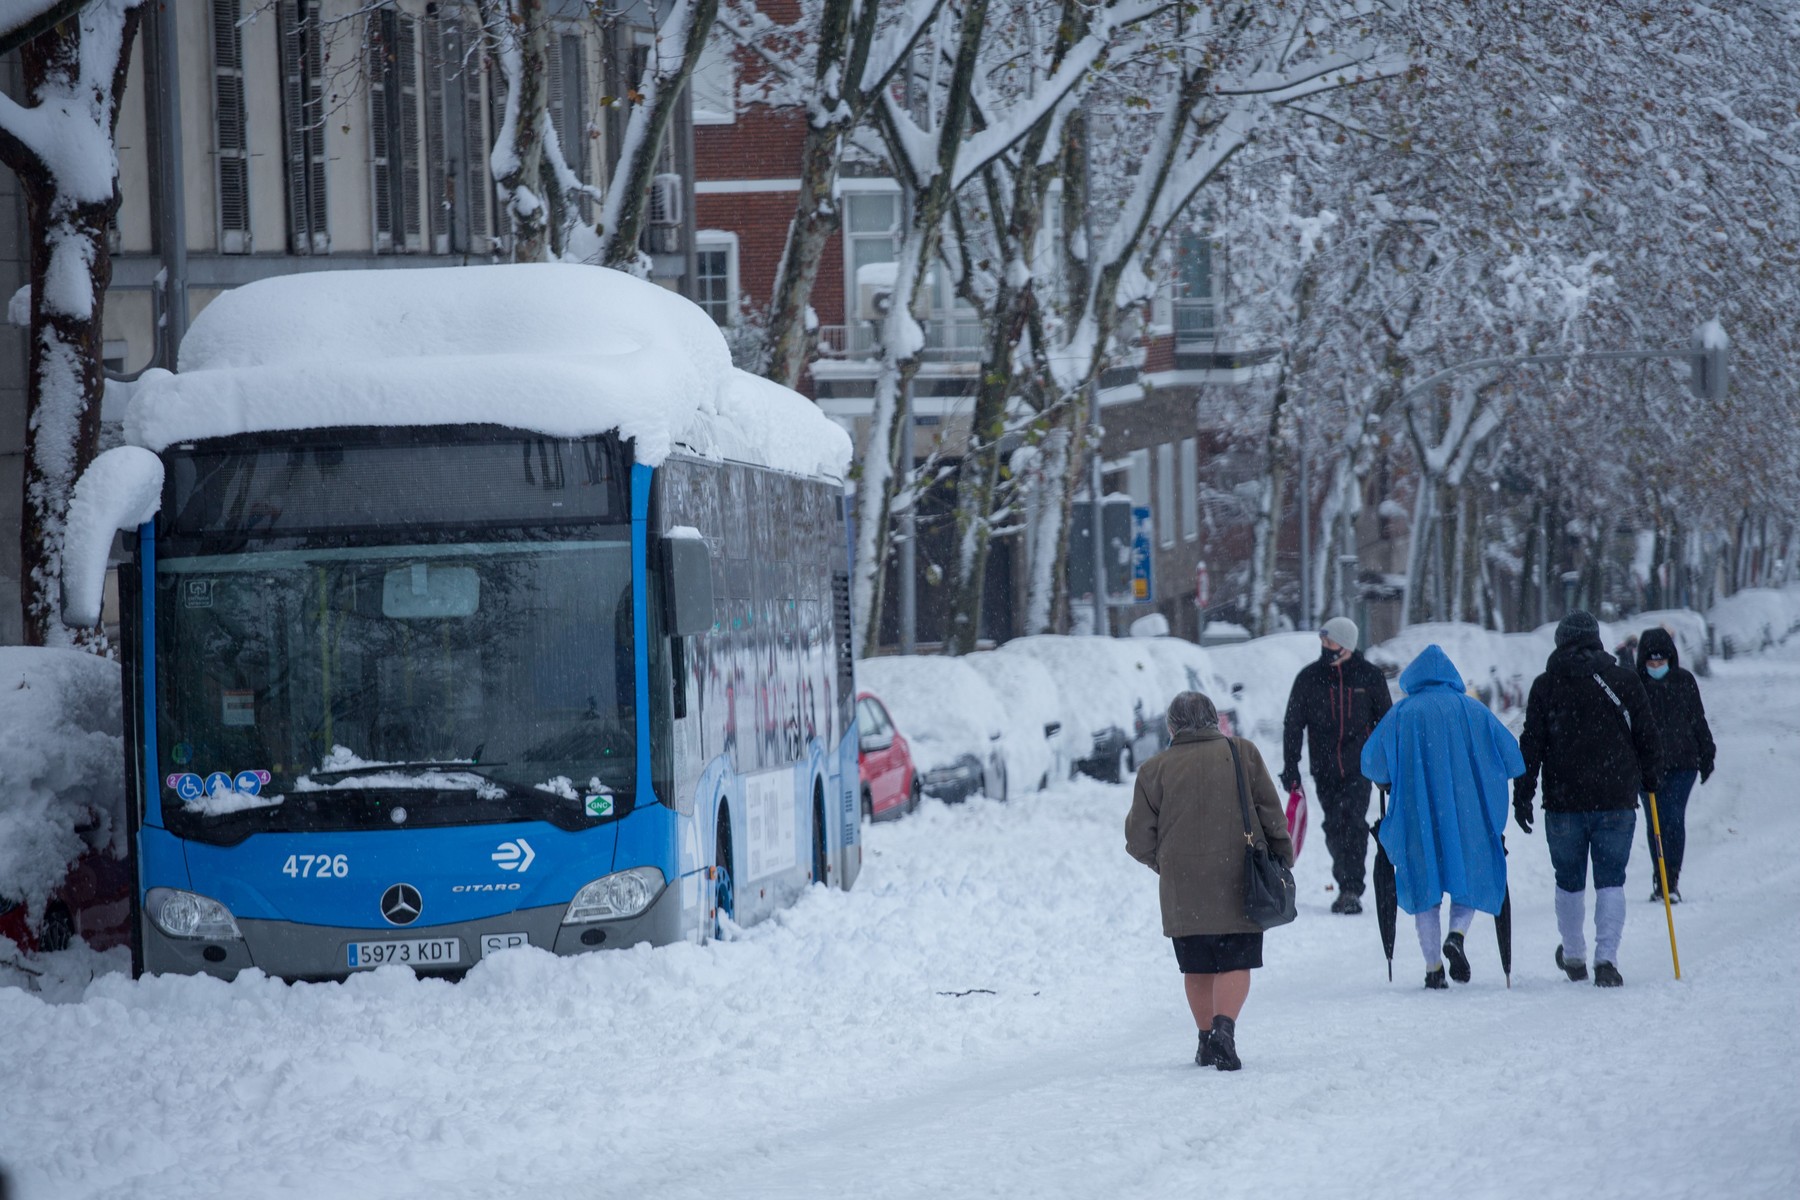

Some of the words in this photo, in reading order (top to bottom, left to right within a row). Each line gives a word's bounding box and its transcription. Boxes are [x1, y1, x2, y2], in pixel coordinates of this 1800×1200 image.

[170, 776, 176, 785] 2
[261, 772, 267, 780] 4
[282, 854, 349, 878] 4726
[452, 883, 521, 893] CITARO
[361, 944, 410, 963] 5973
[418, 941, 455, 961] KDT
